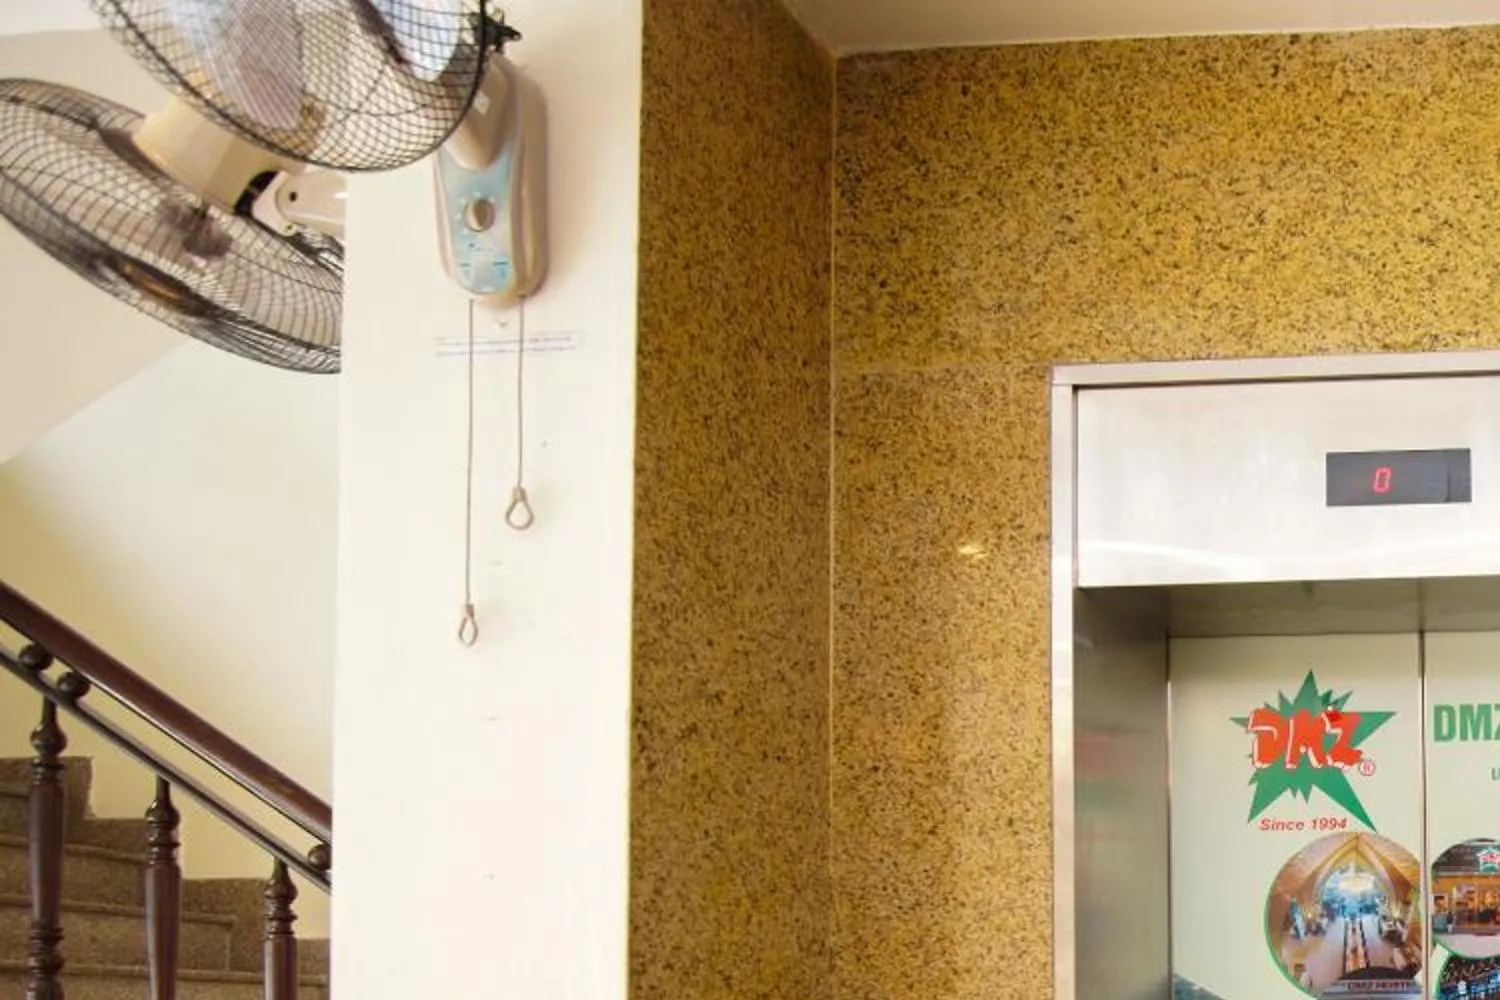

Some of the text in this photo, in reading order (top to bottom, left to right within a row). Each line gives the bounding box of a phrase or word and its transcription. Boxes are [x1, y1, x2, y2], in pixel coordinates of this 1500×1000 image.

[1373, 467, 1393, 493] 0
[1247, 707, 1364, 772] DMZ
[1259, 817, 1347, 831] Since 1994
